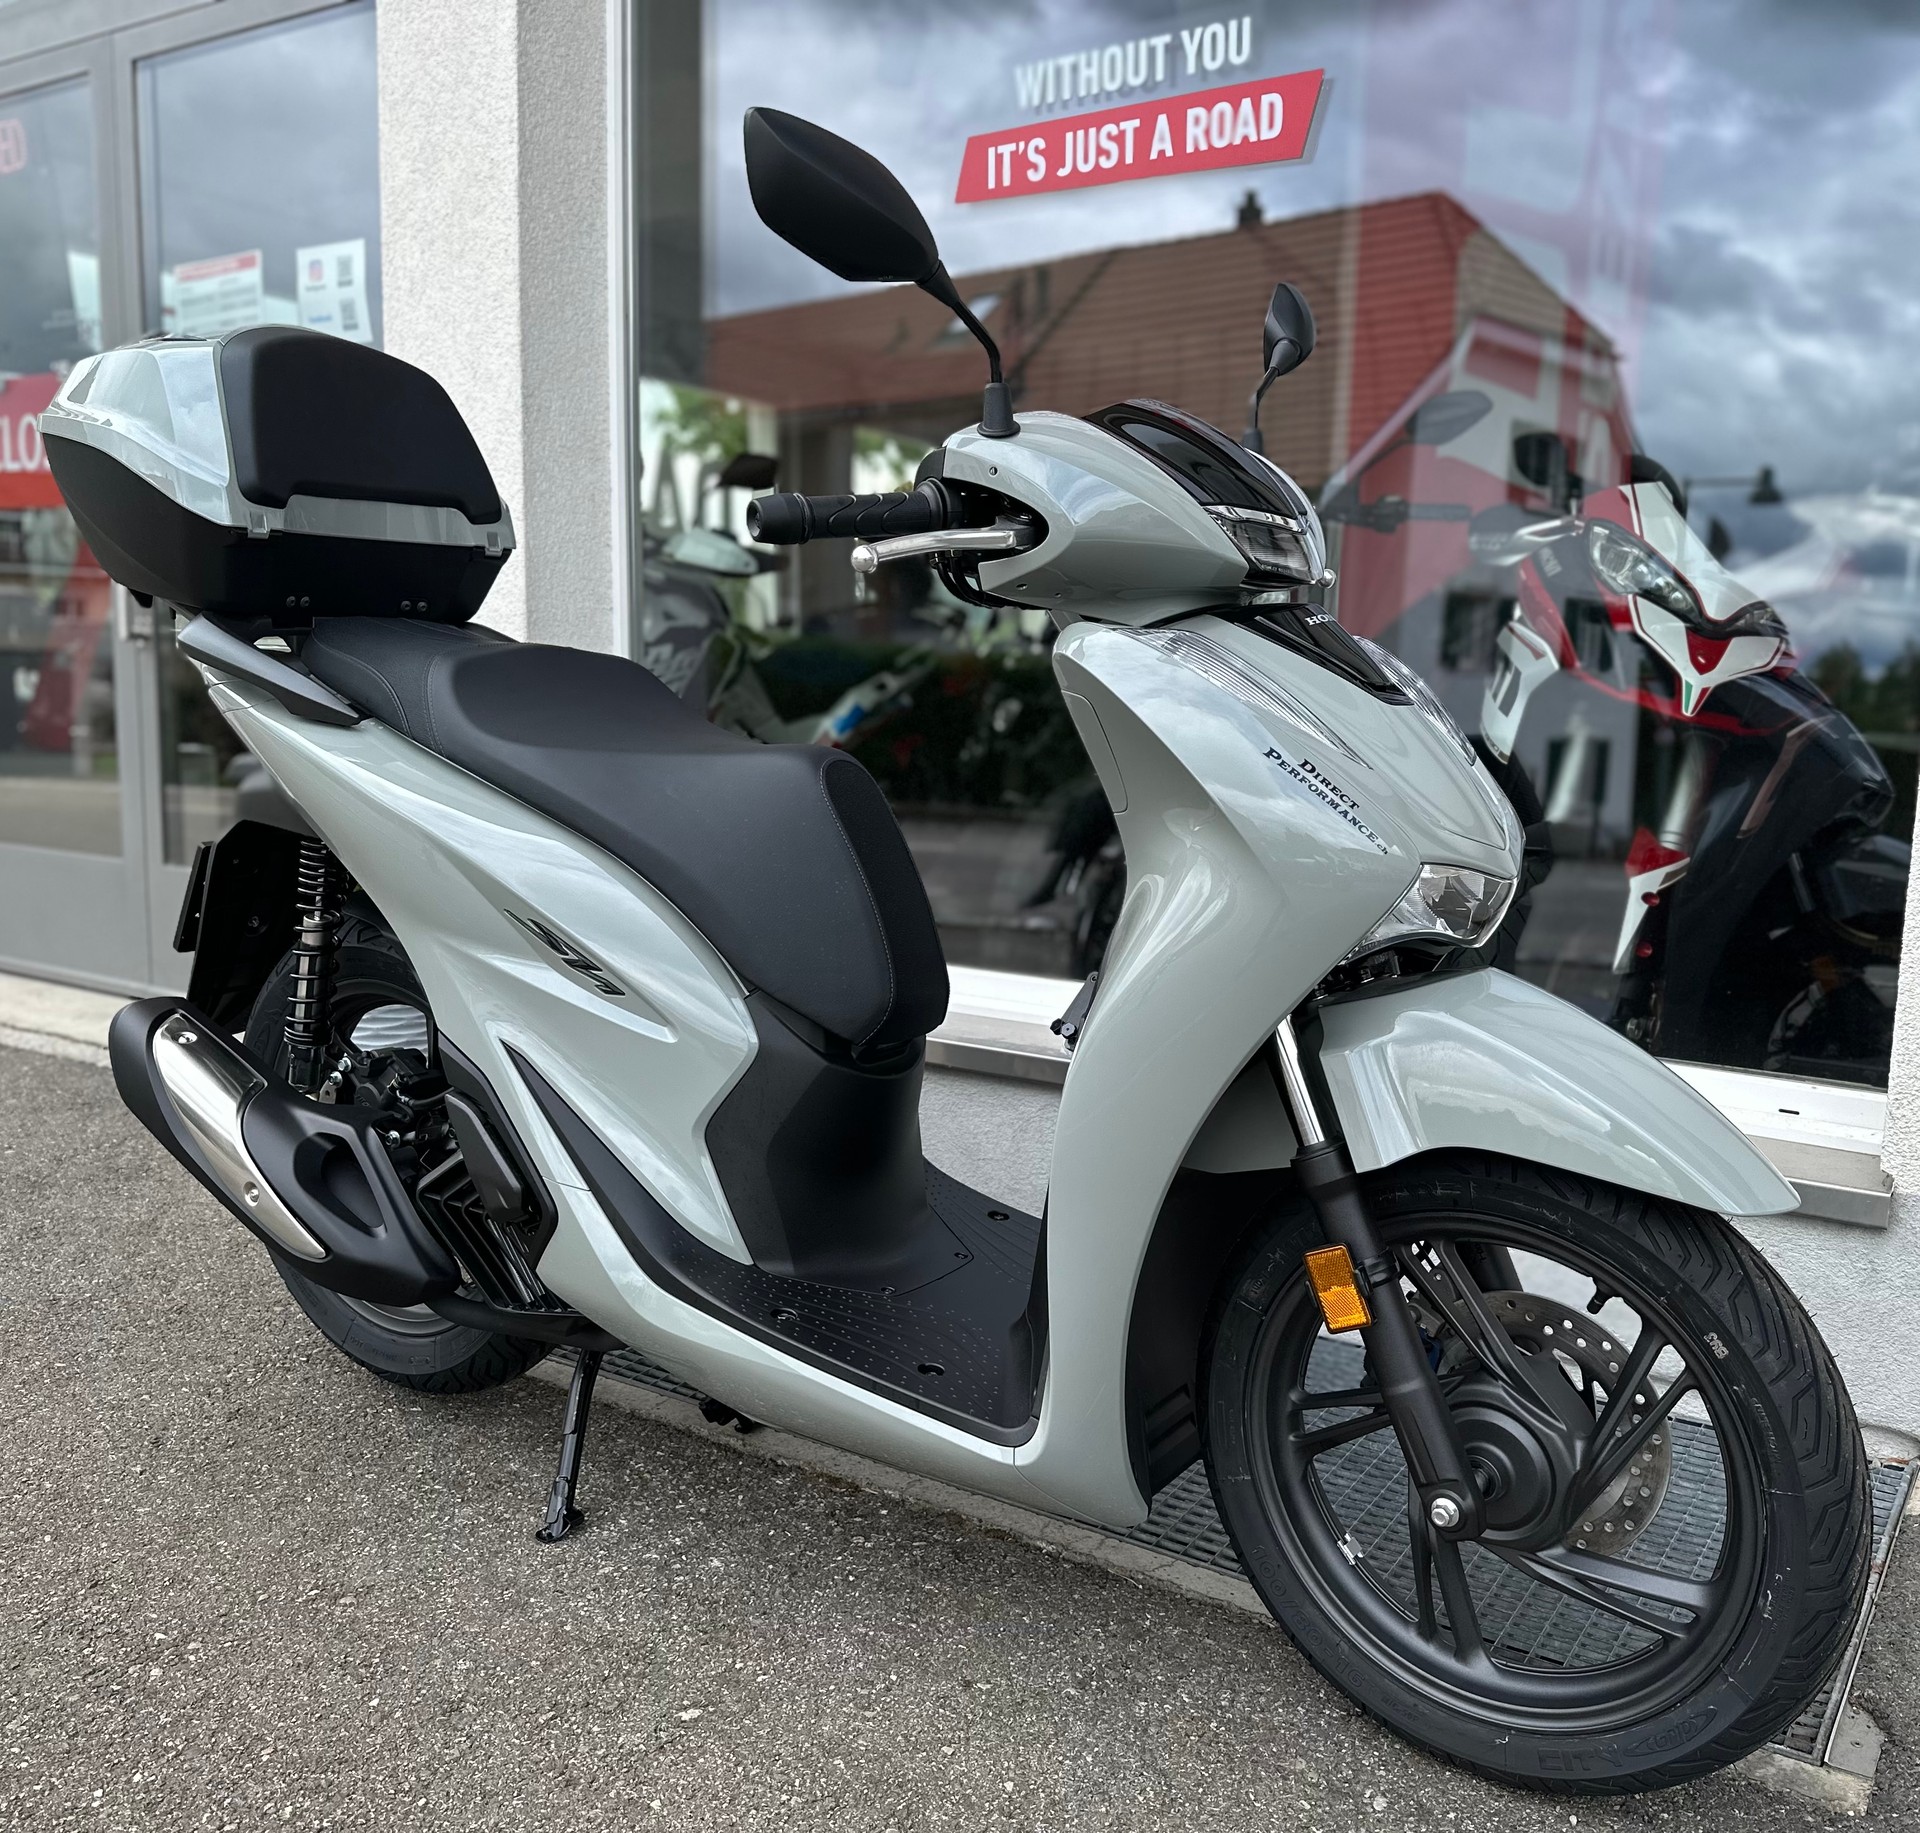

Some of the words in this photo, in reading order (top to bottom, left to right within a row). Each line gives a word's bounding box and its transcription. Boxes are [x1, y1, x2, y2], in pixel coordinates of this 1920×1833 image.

[1015, 34, 1172, 110] WITHOUT
[1180, 16, 1252, 76] YOU
[987, 136, 1046, 190] IT'S
[1056, 118, 1141, 177] JUST
[1149, 113, 1174, 160] A
[1186, 92, 1284, 154] ROAD
[1262, 746, 1388, 855] PERFORMANCE.ch
[1297, 758, 1360, 810] DIRECT
